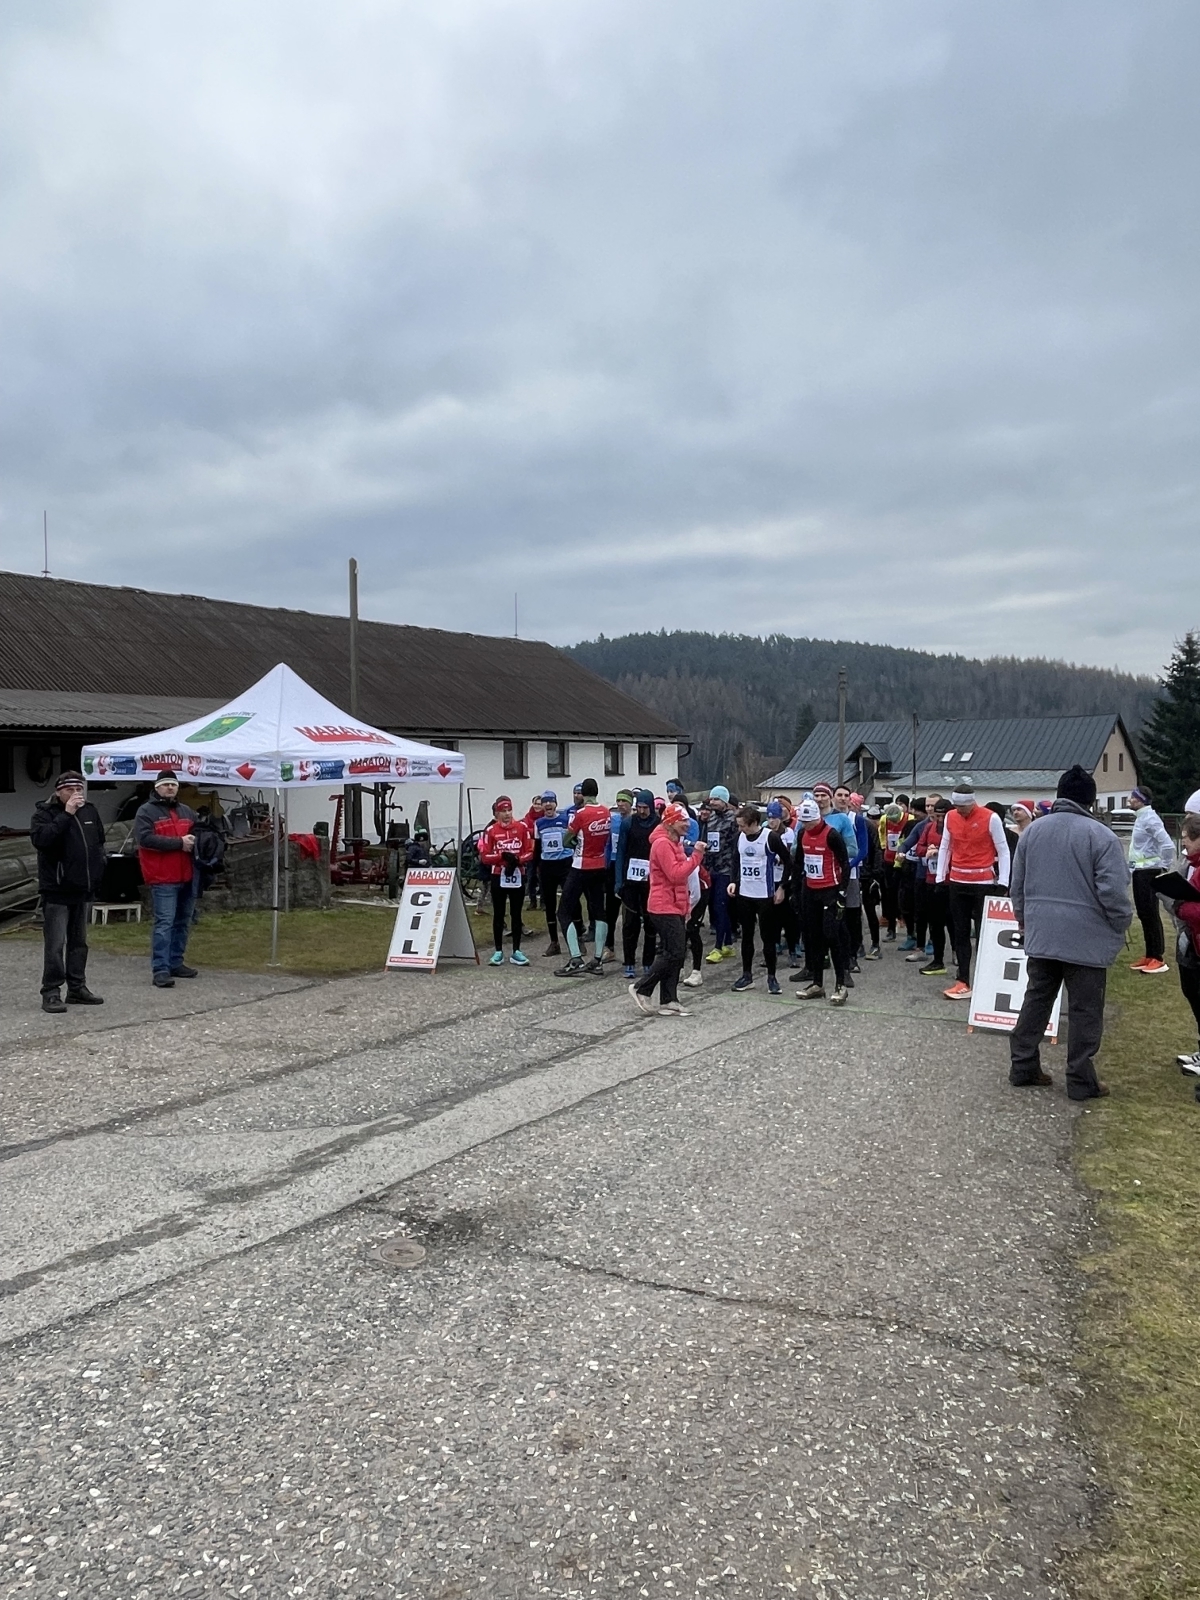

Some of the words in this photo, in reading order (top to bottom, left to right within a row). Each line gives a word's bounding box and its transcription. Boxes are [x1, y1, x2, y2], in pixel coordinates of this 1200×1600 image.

[140, 753, 184, 765] MARATON
[349, 756, 392, 767] MARATON
[631, 867, 646, 877] 118
[742, 867, 760, 877] 236
[806, 863, 819, 874] 181
[408, 870, 453, 880] MARATON
[505, 875, 518, 884] 50
